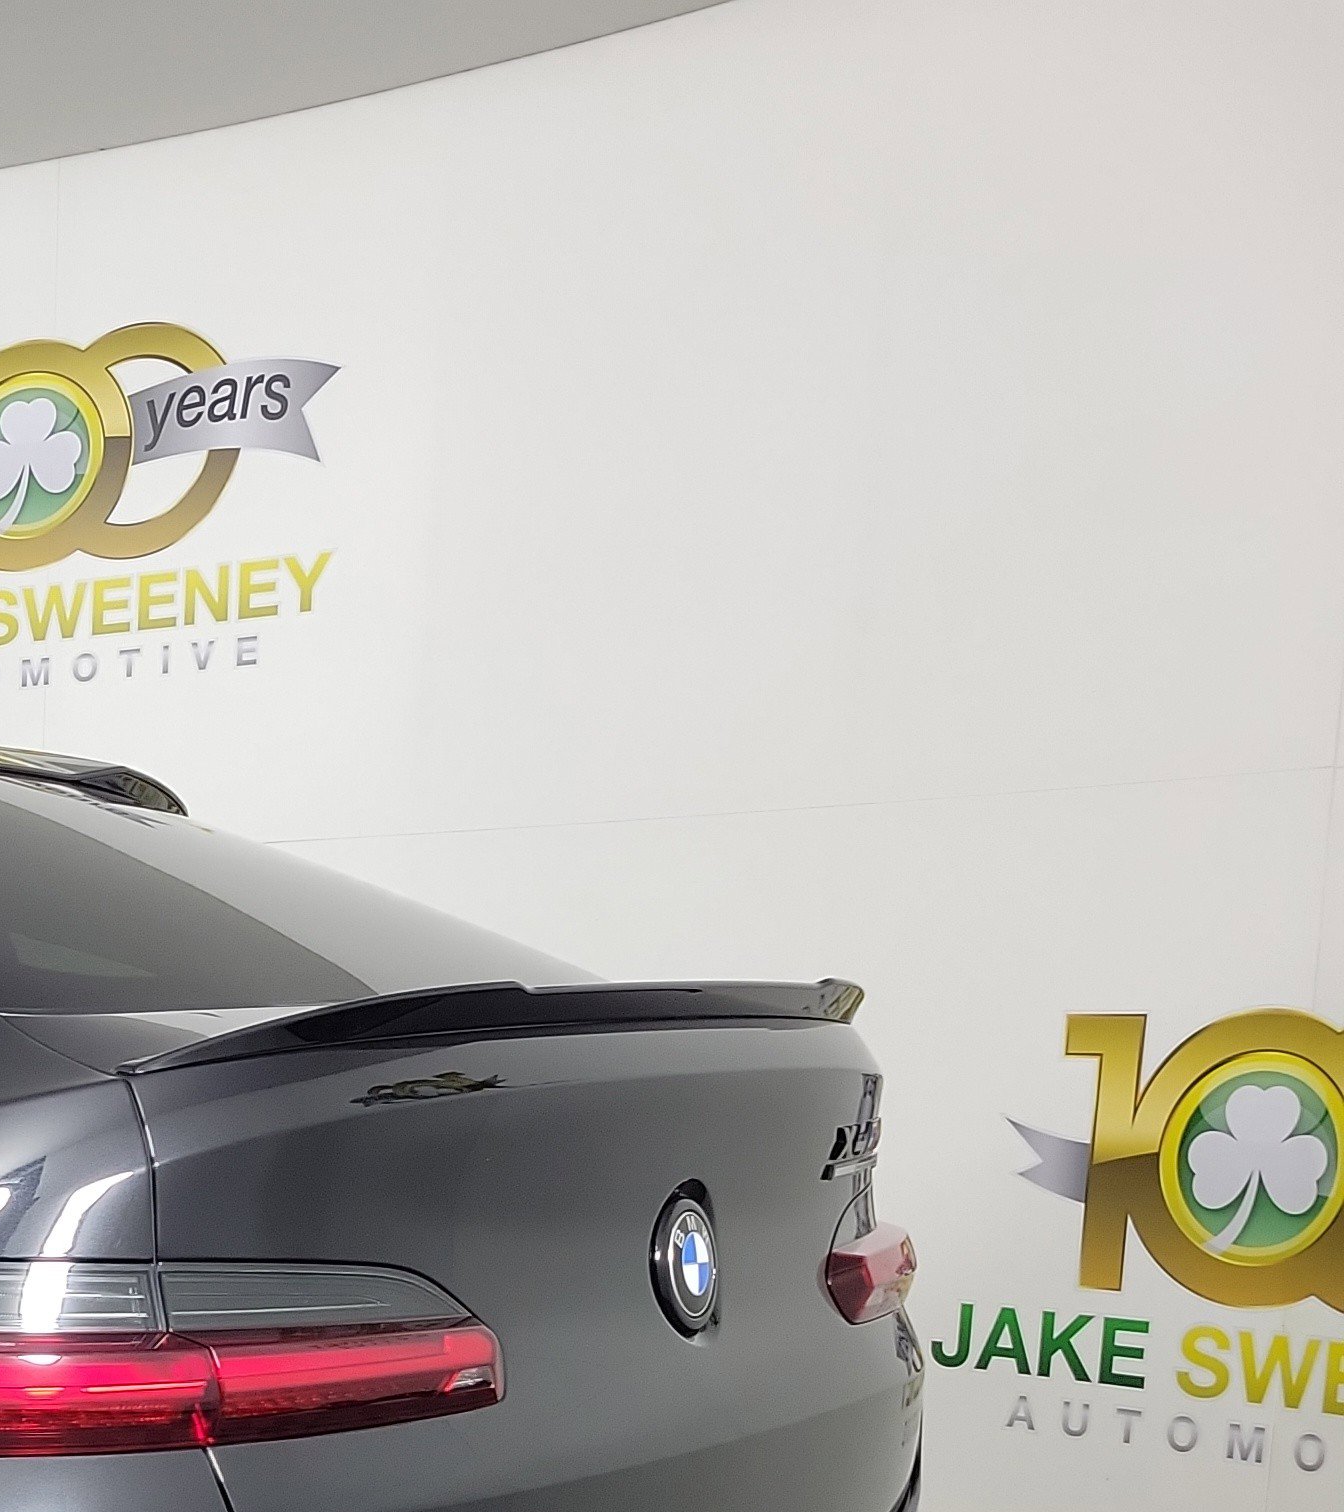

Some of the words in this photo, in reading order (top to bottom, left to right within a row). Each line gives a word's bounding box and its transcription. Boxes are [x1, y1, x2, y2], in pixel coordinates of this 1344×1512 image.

[144, 372, 291, 452] years
[1064, 1008, 1344, 1315] 10
[931, 1302, 1150, 1390] JAKE
